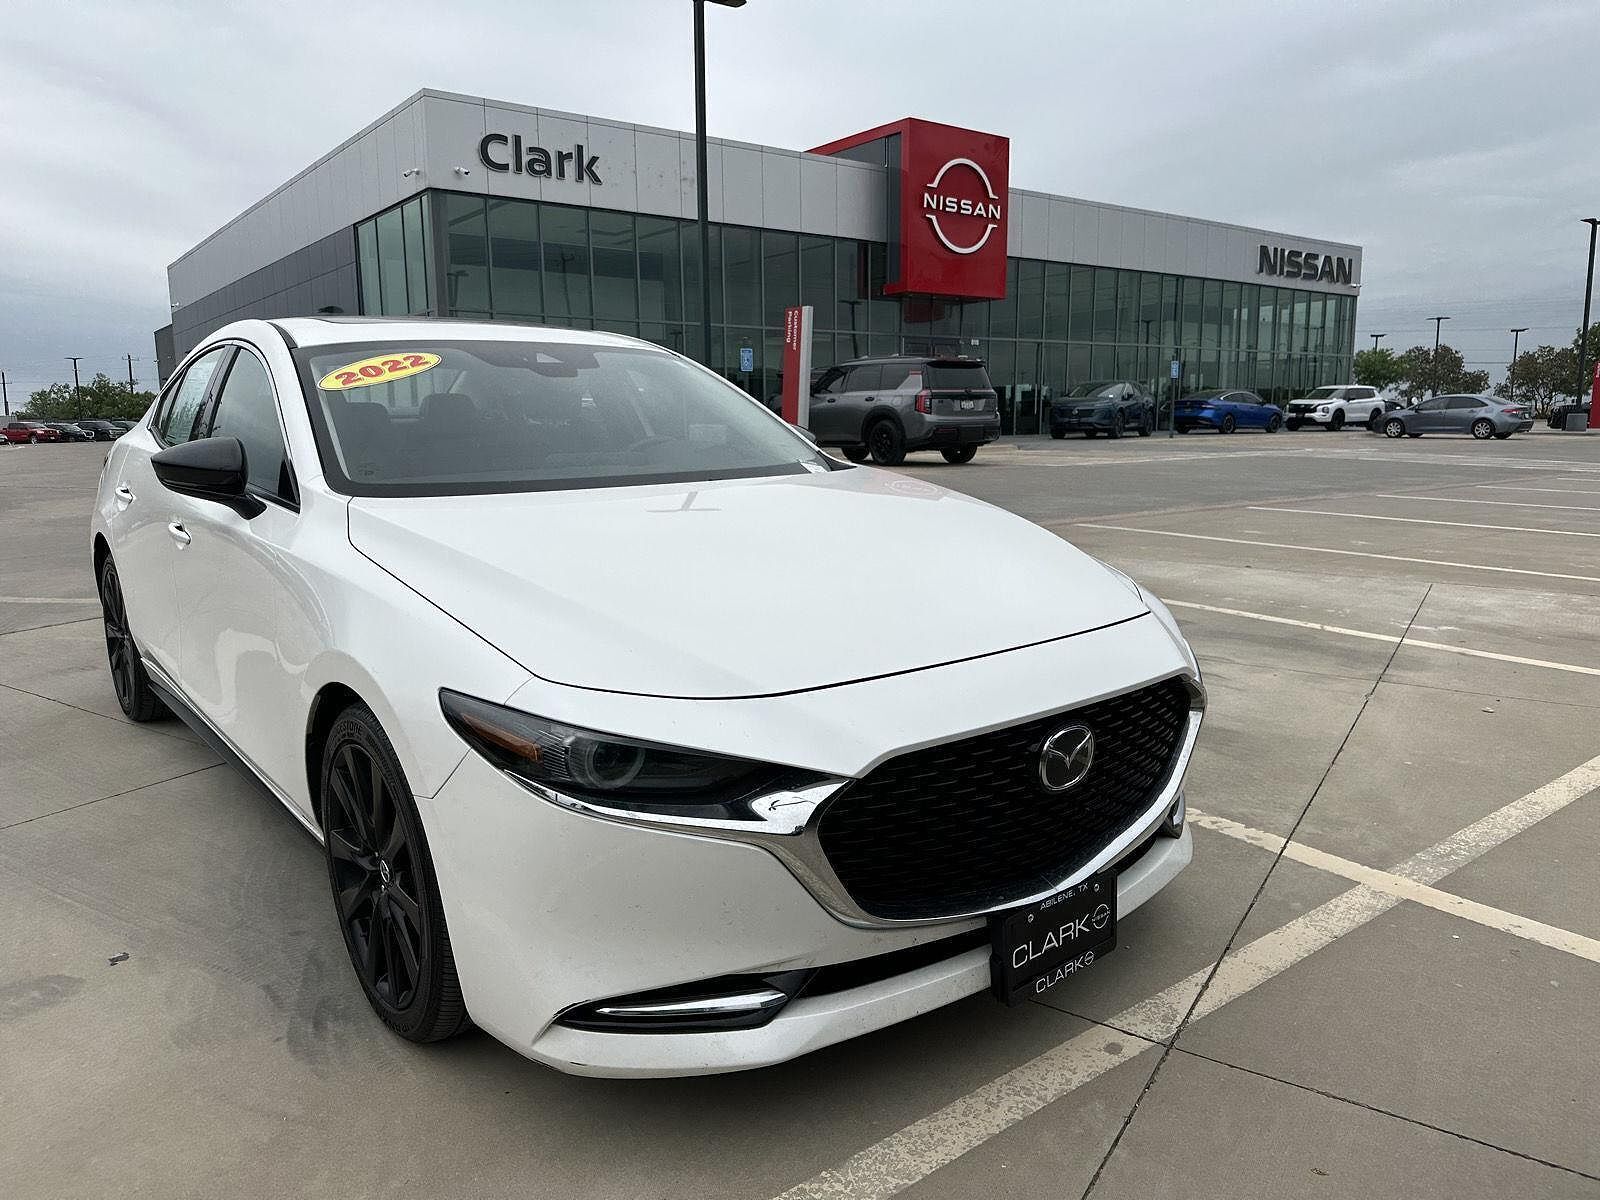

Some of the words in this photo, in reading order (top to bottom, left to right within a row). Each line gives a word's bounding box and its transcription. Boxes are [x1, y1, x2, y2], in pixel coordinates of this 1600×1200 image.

[479, 133, 603, 186] Clark
[923, 192, 1001, 220] NISSAN
[1256, 244, 1353, 285] NISSAN
[335, 355, 431, 386] 2022
[1078, 882, 1089, 892] TX
[1013, 914, 1090, 968] CLARK
[1036, 956, 1084, 993] CLARK
